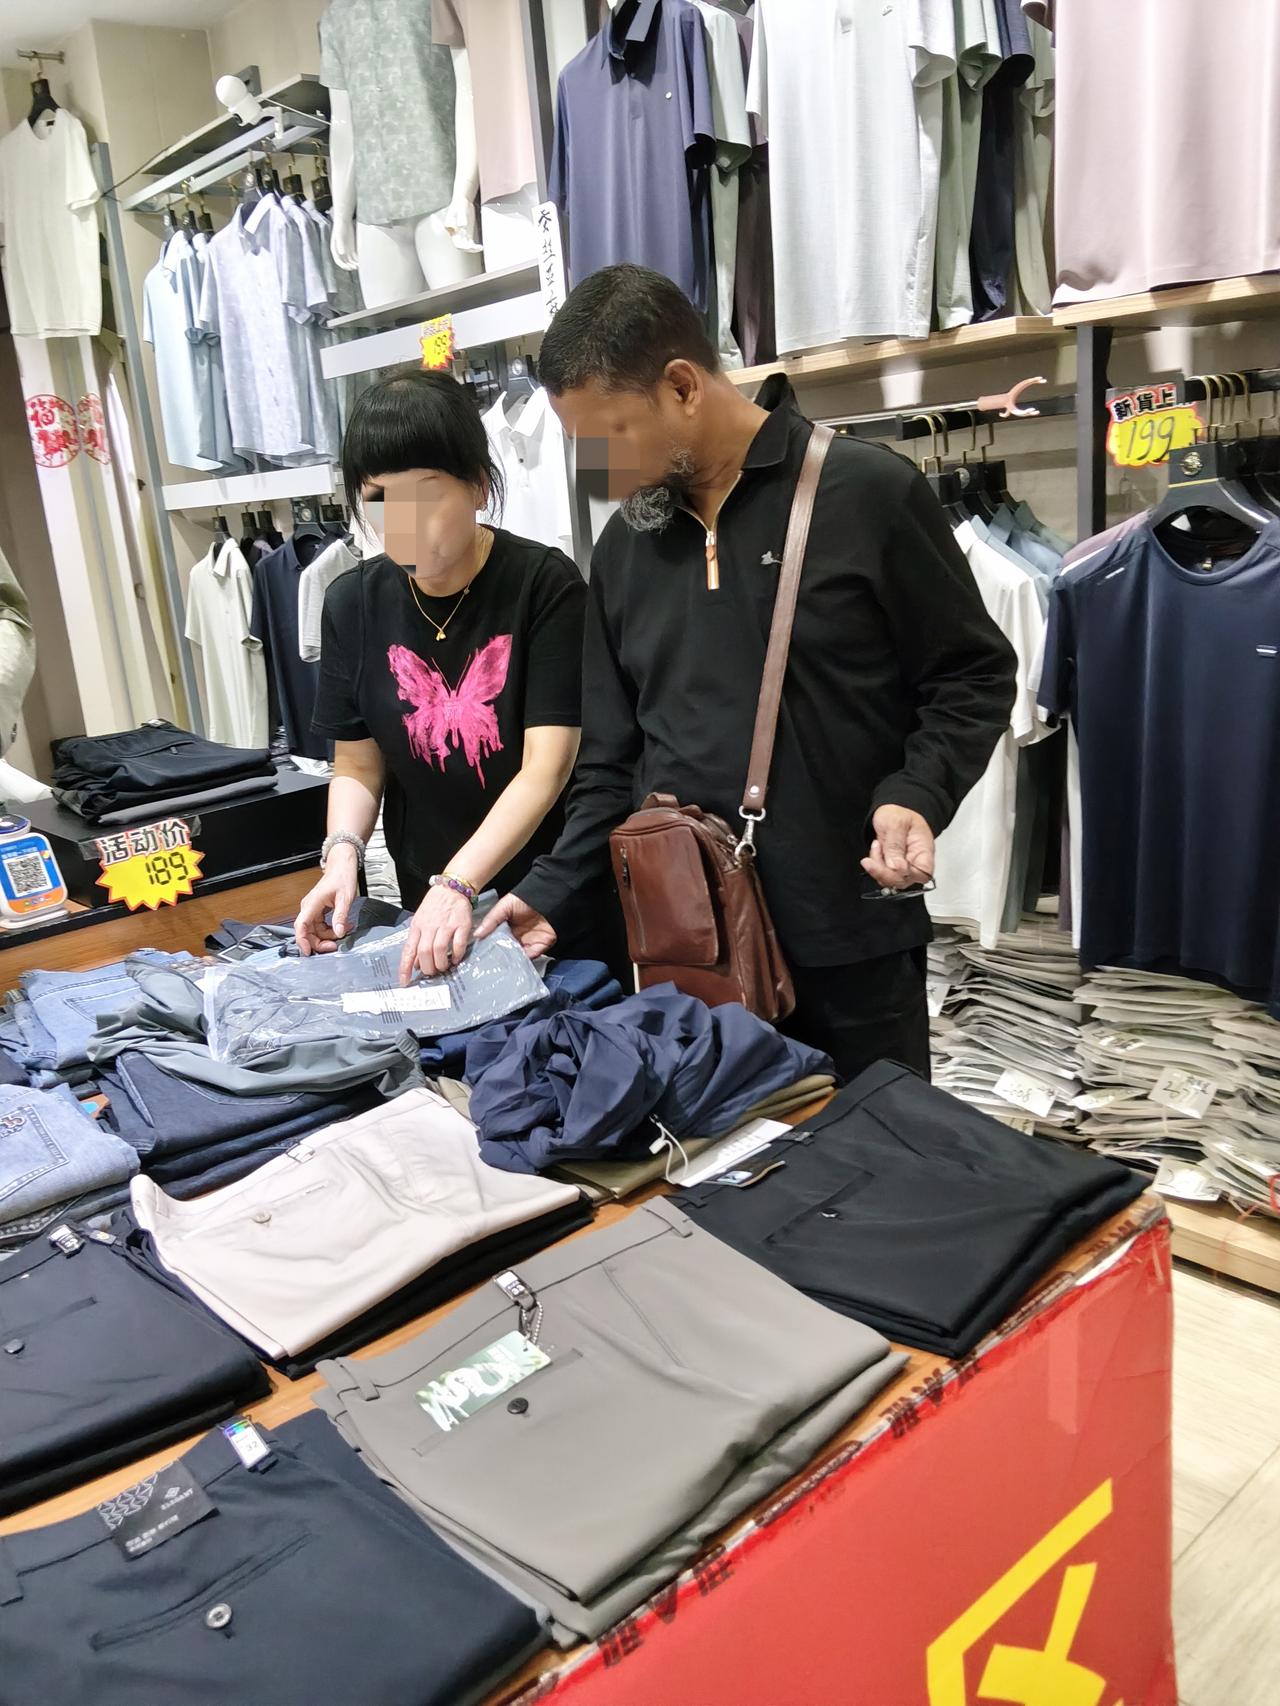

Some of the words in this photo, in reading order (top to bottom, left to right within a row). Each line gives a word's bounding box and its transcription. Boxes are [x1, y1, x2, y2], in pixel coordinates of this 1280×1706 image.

[1113, 389, 1194, 420] 新貨上
[1125, 416, 1175, 462] 199
[101, 821, 186, 863] 活动价
[145, 851, 189, 885] 189
